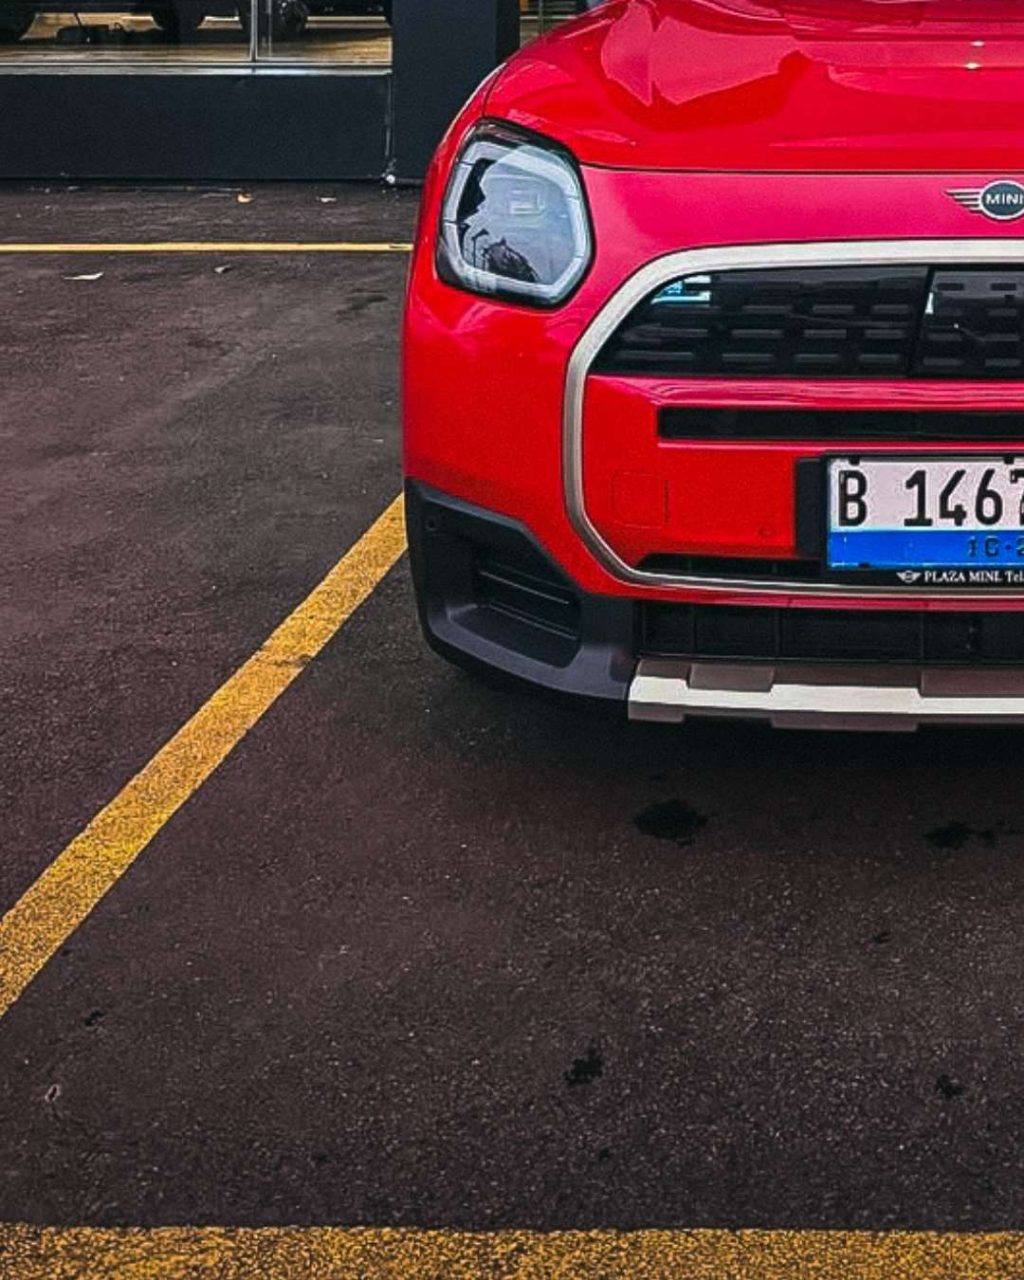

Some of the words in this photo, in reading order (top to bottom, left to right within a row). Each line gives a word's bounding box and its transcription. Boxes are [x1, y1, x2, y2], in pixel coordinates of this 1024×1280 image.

[985, 193, 1024, 206] MINI
[838, 470, 867, 527] B
[924, 570, 966, 582] PLAZA
